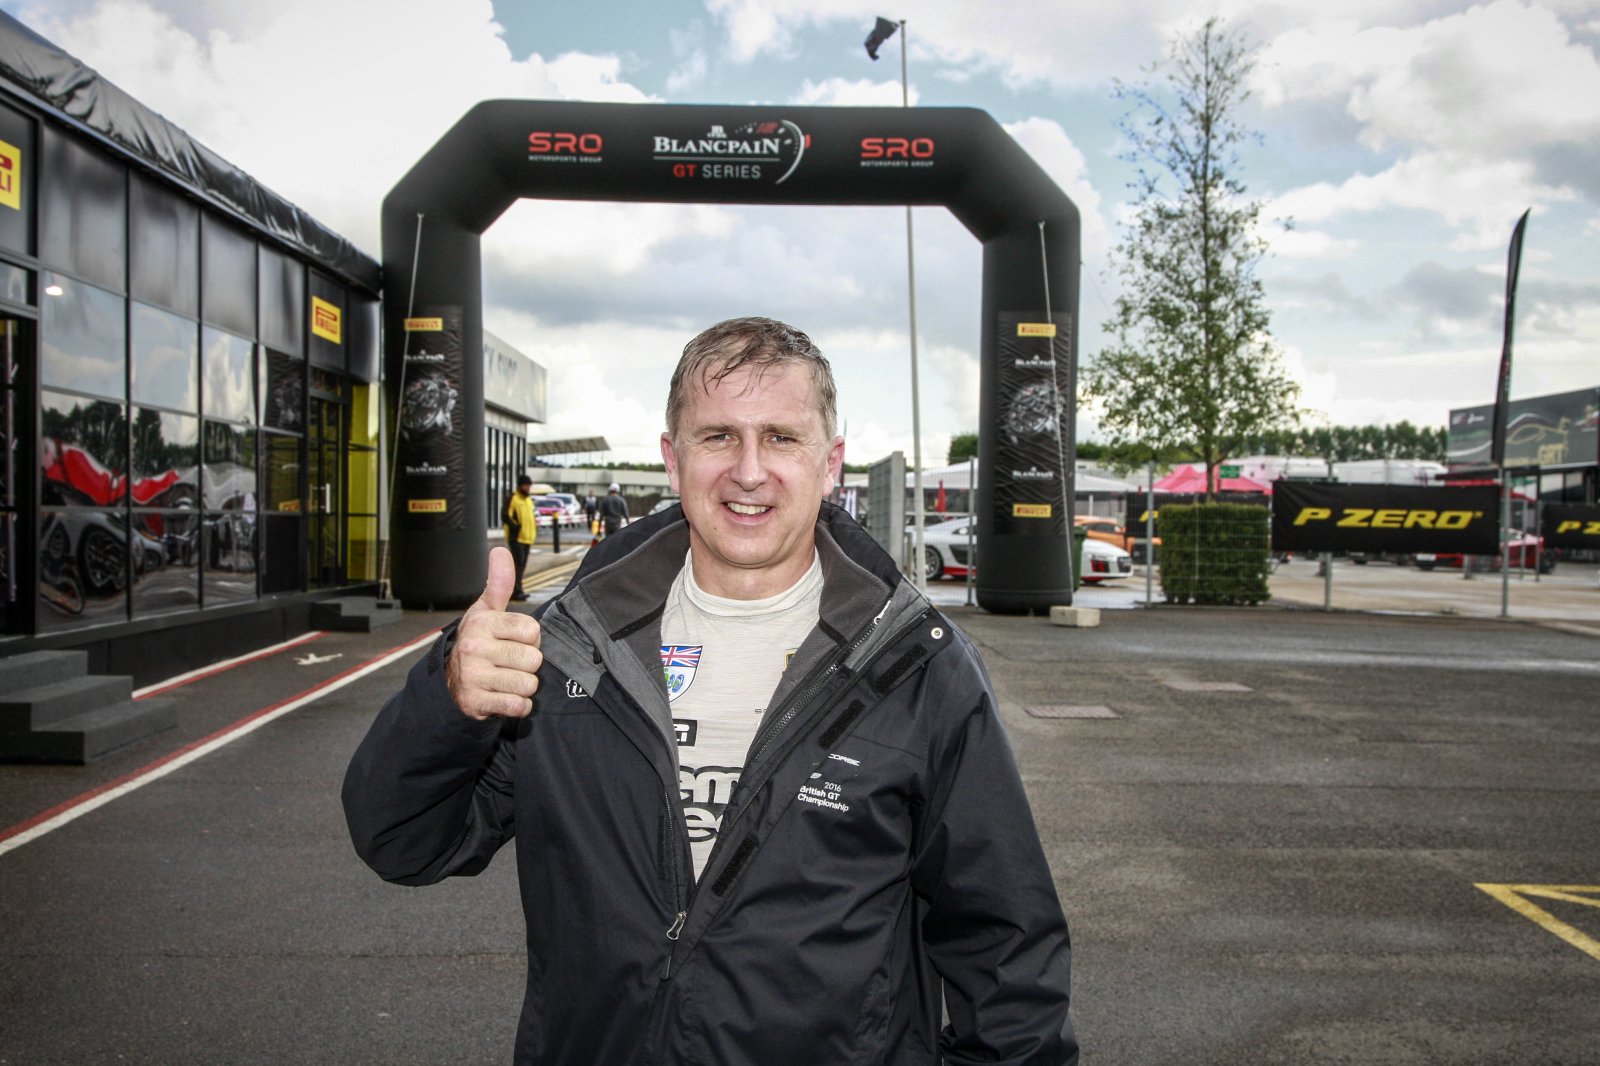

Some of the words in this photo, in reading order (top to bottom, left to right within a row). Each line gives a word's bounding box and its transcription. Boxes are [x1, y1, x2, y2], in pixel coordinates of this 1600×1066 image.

[528, 132, 602, 153] SRO
[861, 137, 934, 158] SRO
[673, 164, 697, 177] GT
[702, 164, 761, 179] SERIES
[1293, 508, 1331, 525] P
[1336, 508, 1474, 529] ZERO
[1556, 520, 1581, 534] P
[799, 785, 827, 798] British
[827, 791, 841, 801] GT
[824, 782, 842, 792] 2016
[797, 793, 850, 812] Championship
